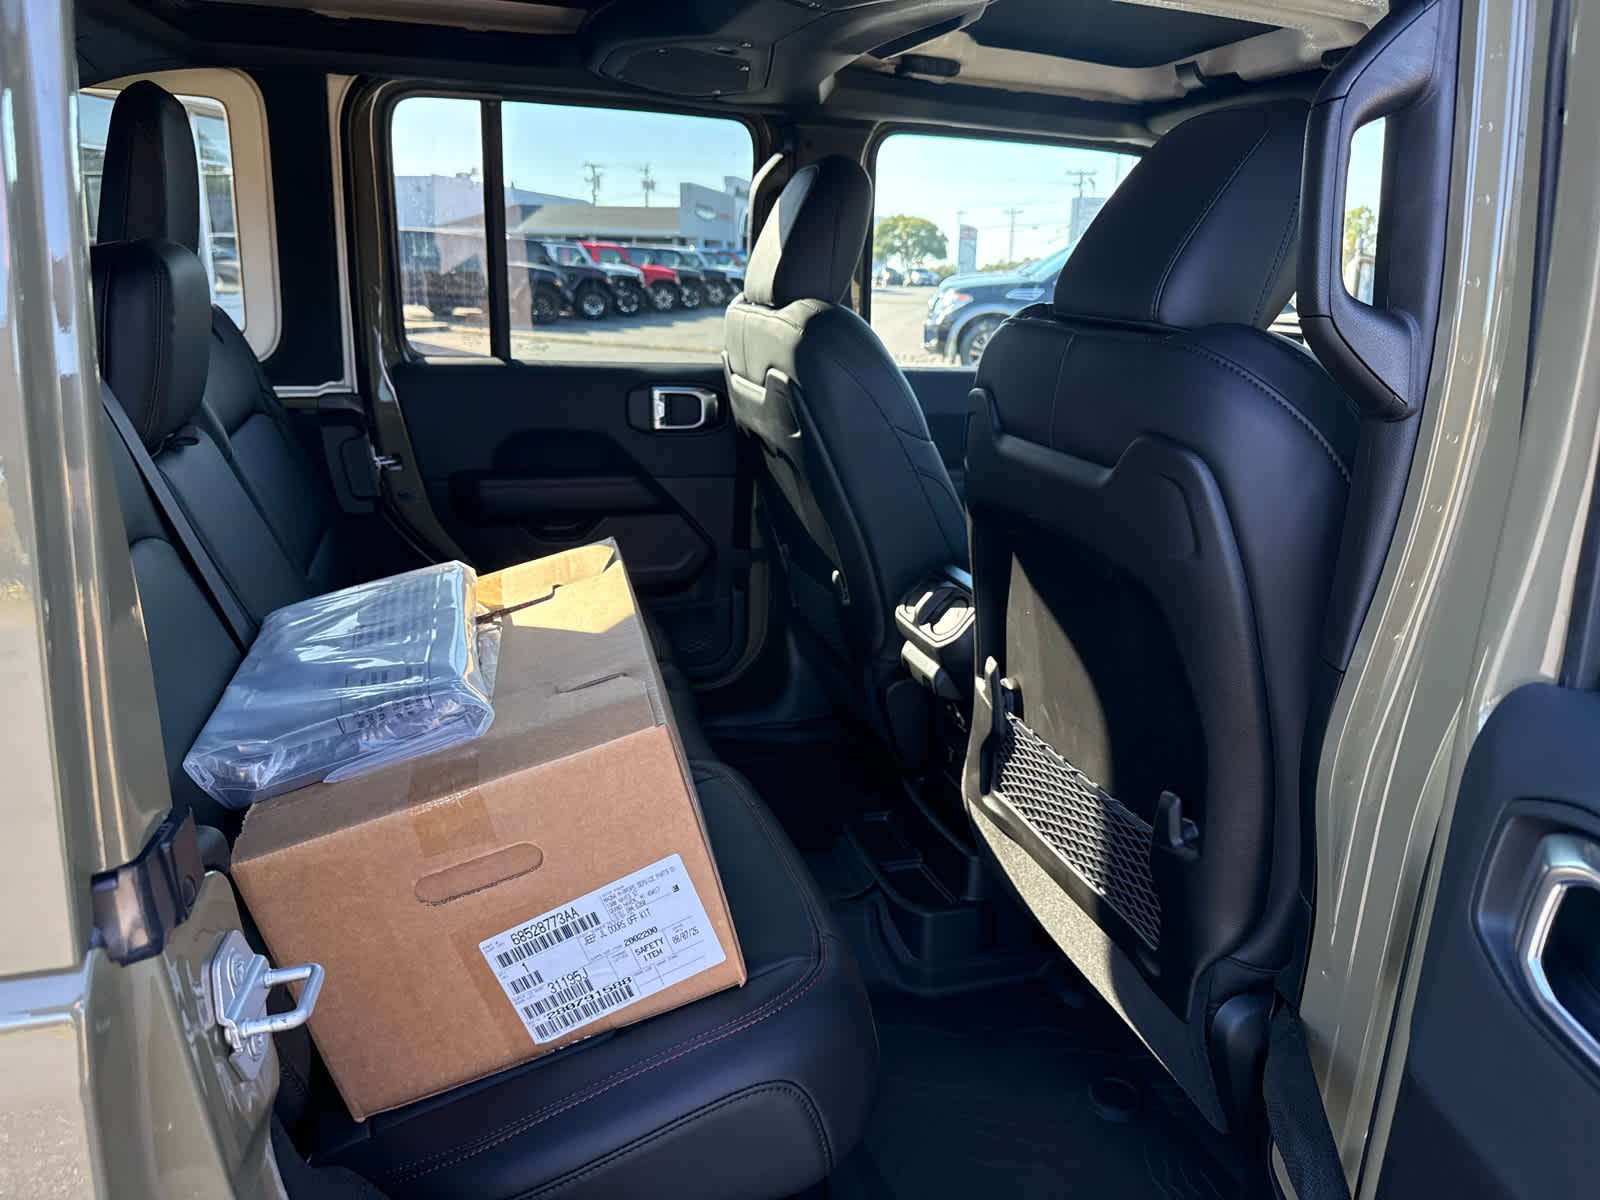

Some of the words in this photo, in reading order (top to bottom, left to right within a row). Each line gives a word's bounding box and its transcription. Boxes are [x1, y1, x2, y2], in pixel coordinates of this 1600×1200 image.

[509, 905, 580, 946] 68528773AA
[622, 925, 658, 947] 2002200
[633, 936, 665, 956] SAFETY
[642, 947, 663, 962] ITEM
[520, 962, 530, 973] 1
[545, 966, 590, 995] 31195J
